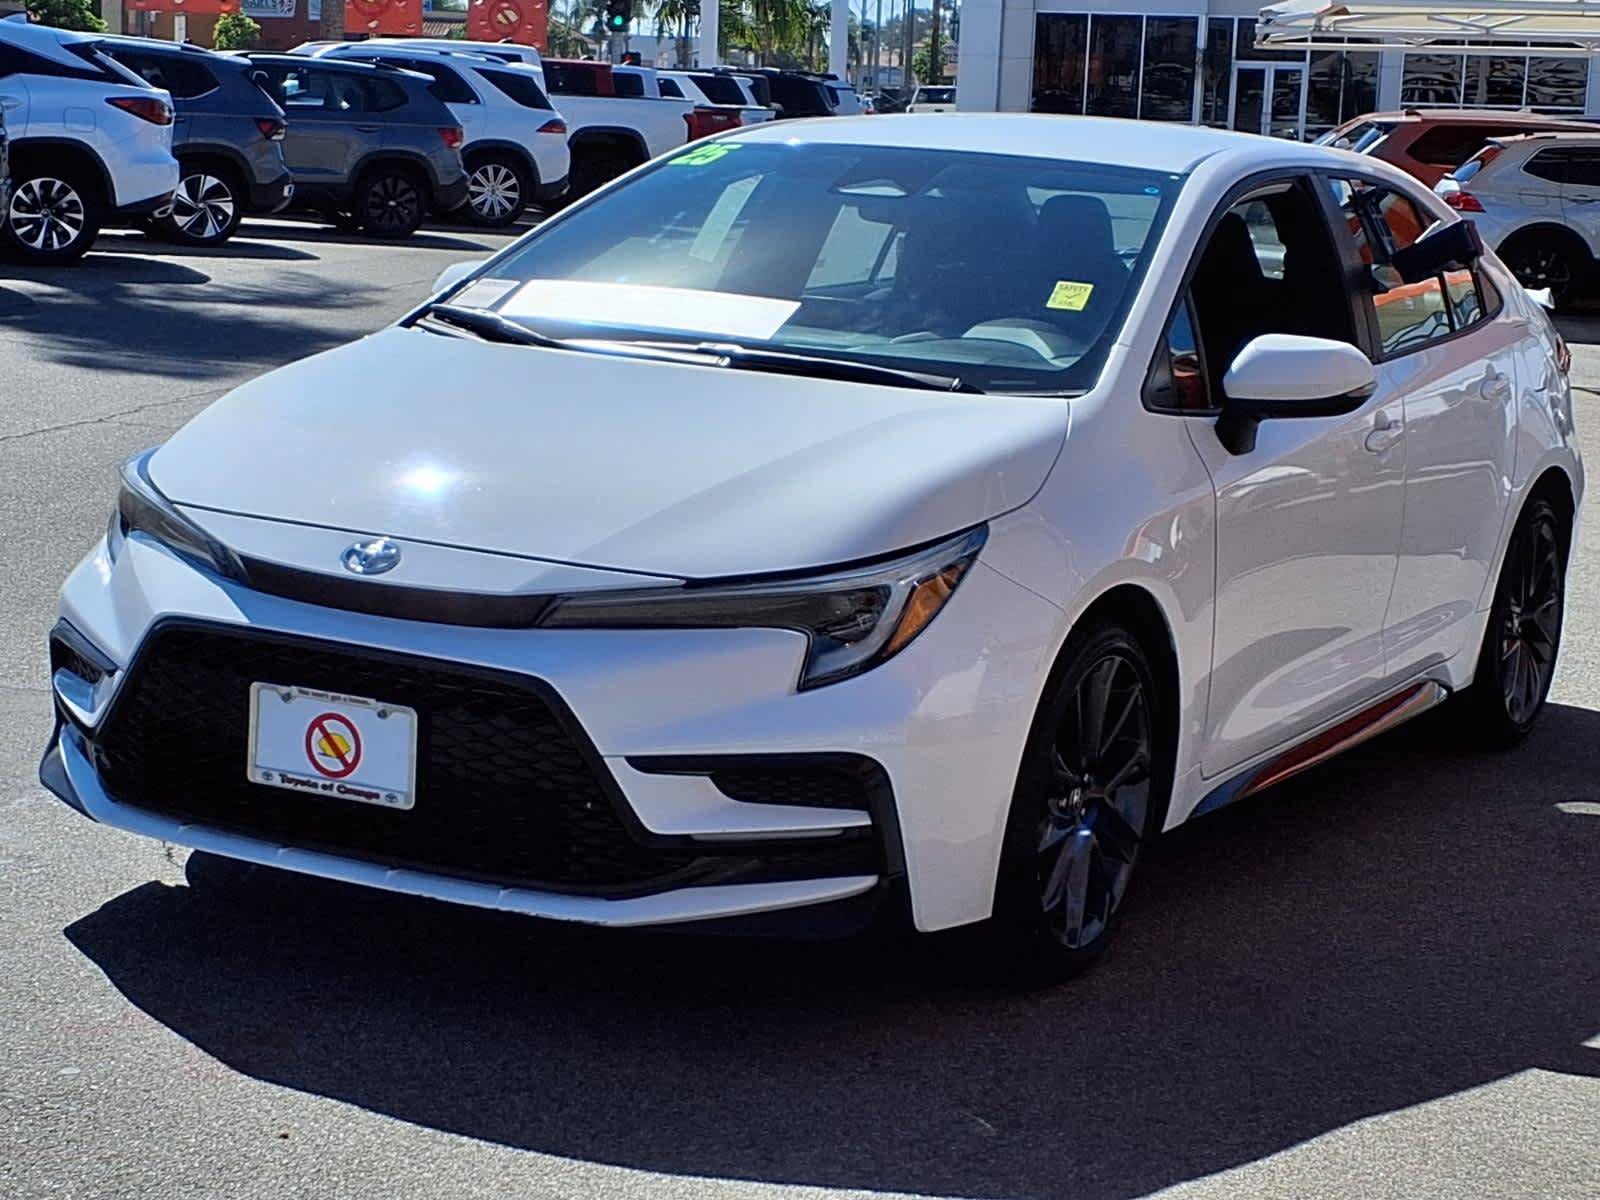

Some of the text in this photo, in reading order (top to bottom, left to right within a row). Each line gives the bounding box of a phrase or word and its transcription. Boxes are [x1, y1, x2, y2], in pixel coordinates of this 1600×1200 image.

[667, 143, 743, 166] 25
[279, 773, 380, 800] Toyota of Orange
